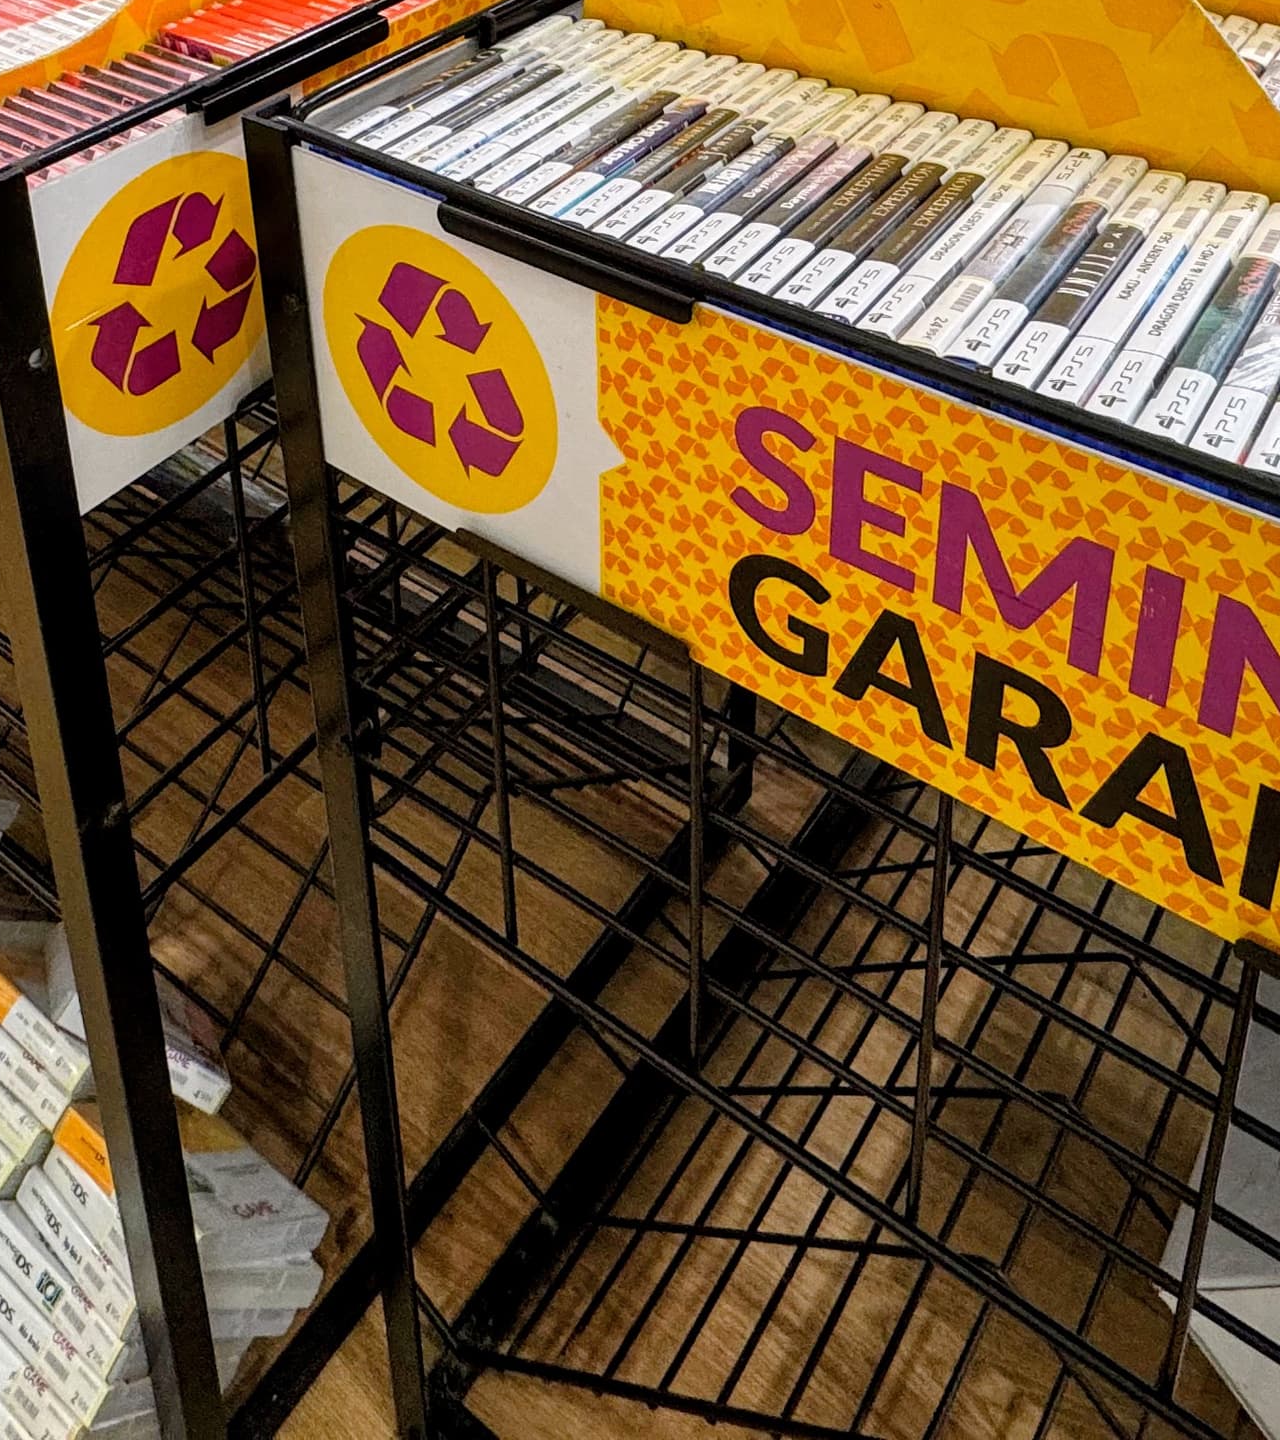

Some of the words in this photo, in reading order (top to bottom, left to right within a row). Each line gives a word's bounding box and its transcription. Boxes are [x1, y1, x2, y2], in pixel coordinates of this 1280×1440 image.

[1057, 253, 1116, 297] UNTIL
[1117, 276, 1140, 300] KAKU
[1140, 243, 1164, 274] ANCIENT
[1162, 232, 1171, 244] SEA
